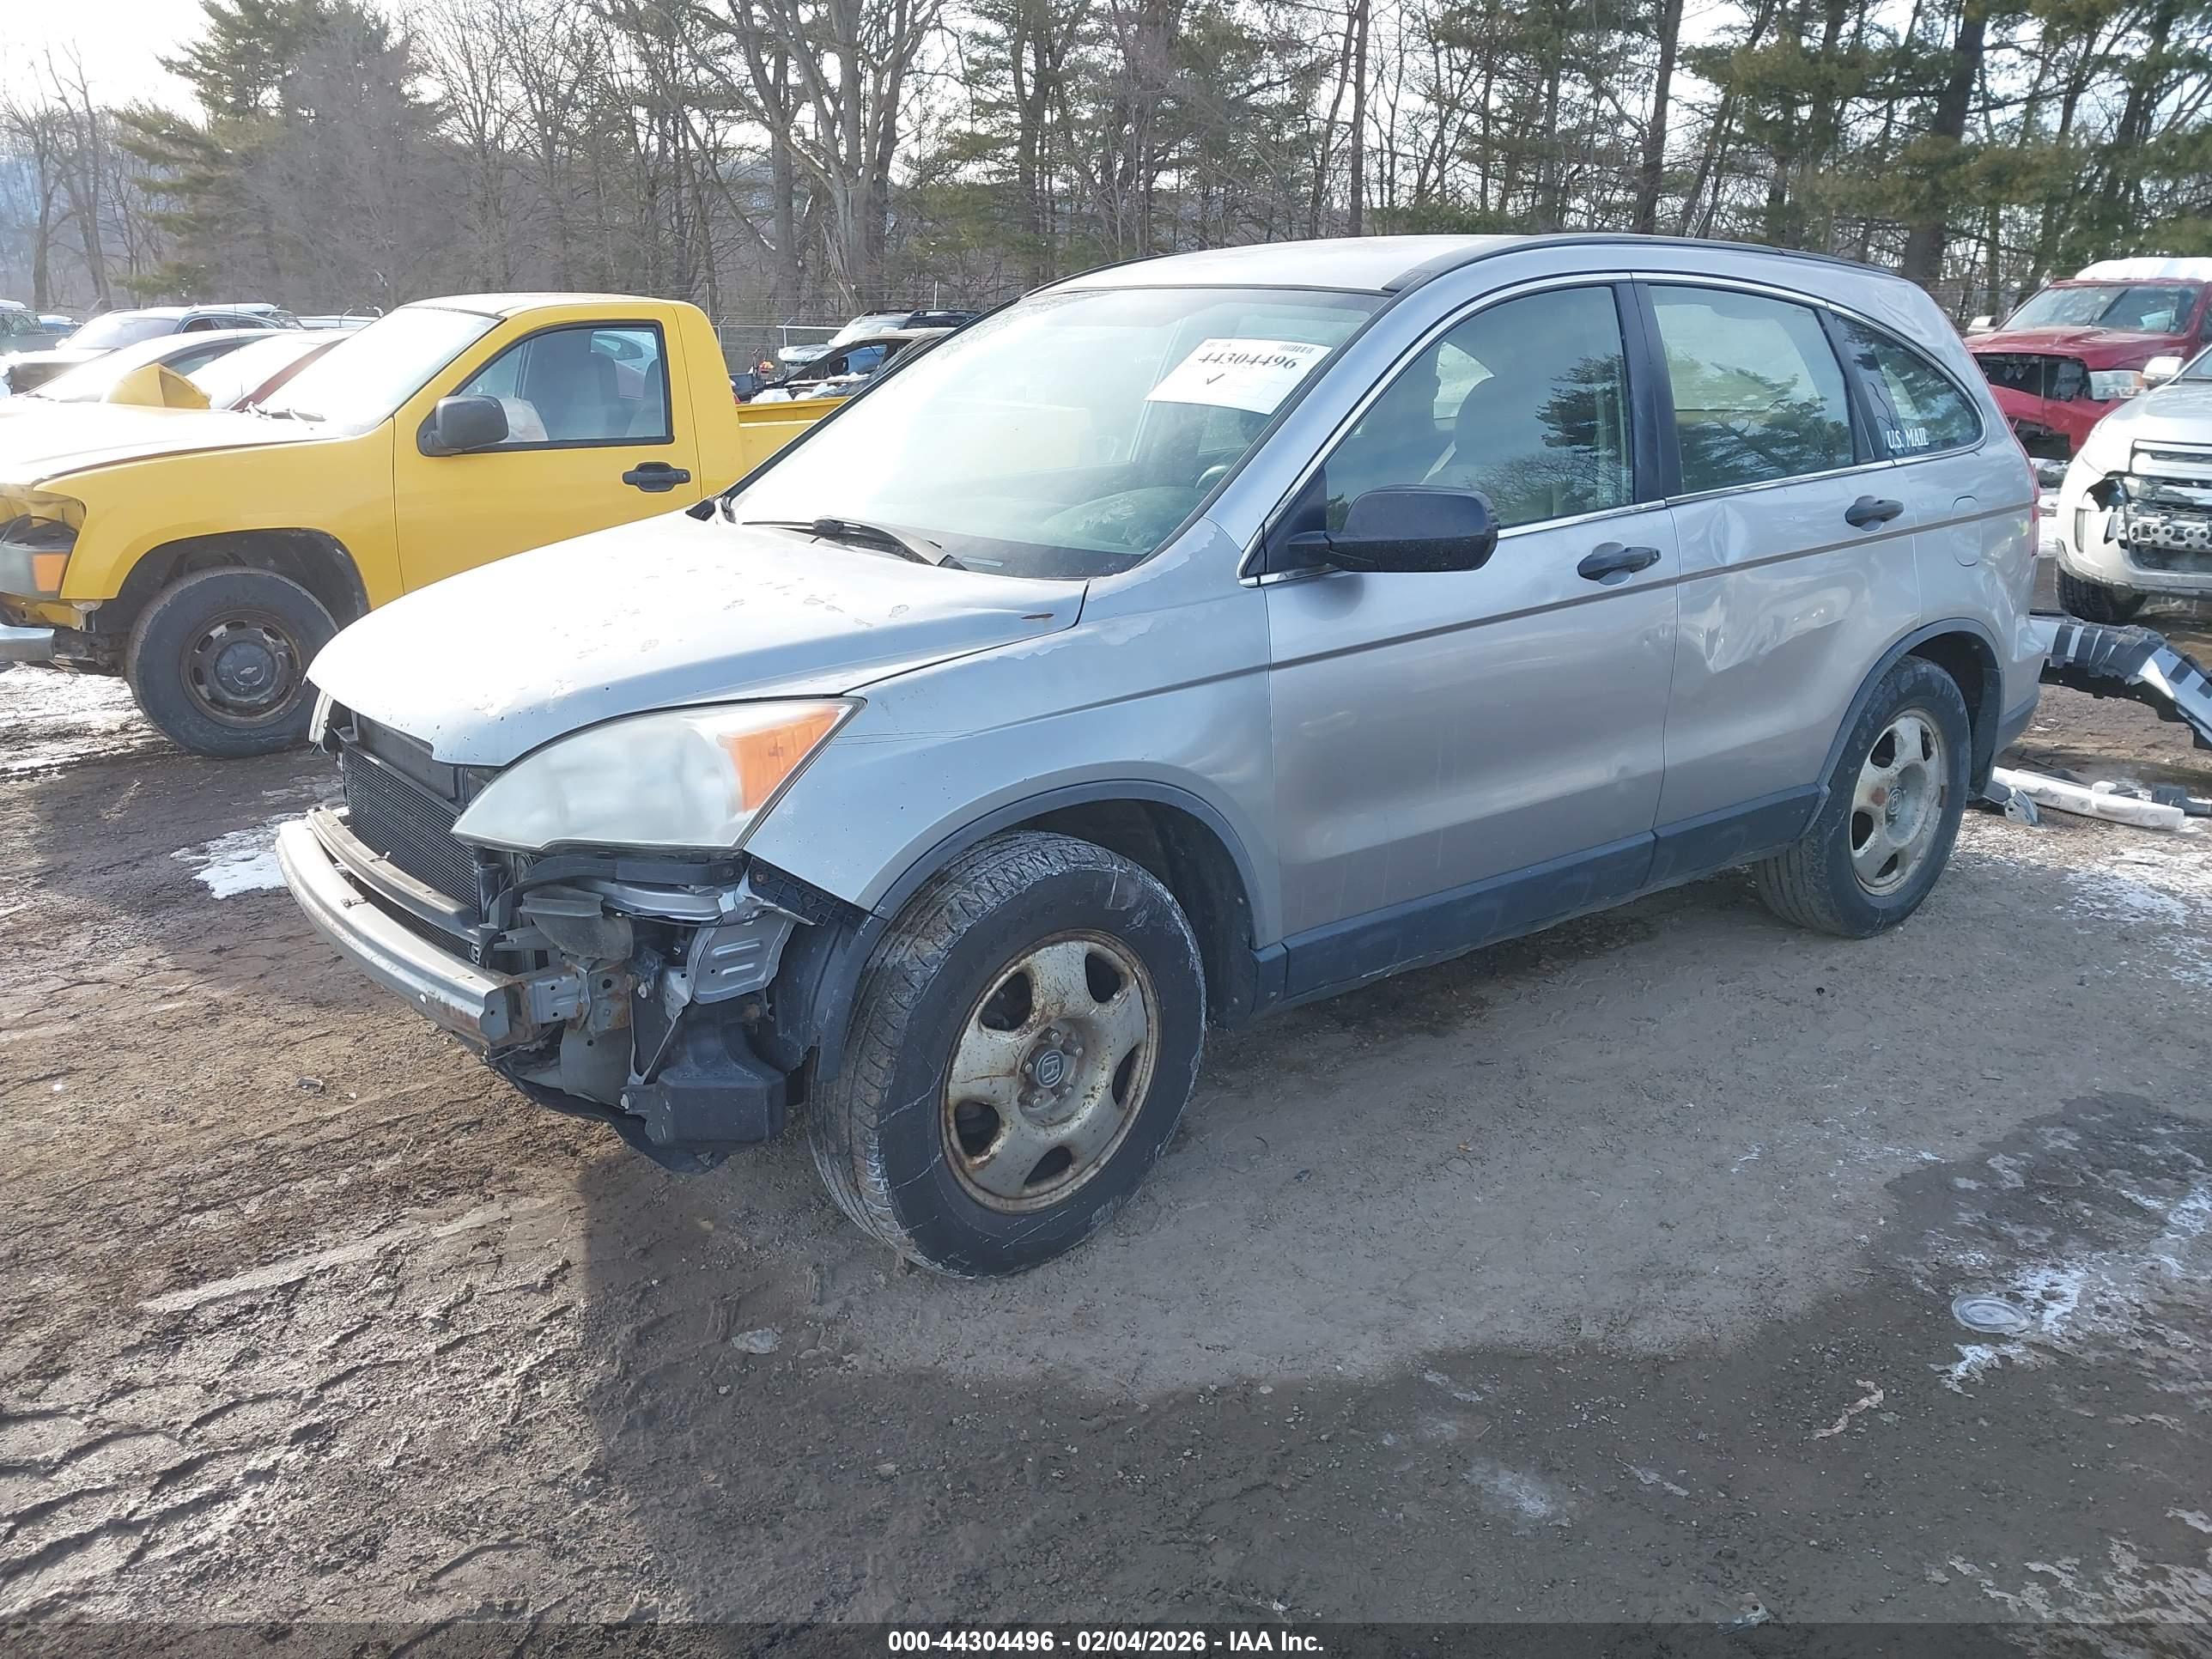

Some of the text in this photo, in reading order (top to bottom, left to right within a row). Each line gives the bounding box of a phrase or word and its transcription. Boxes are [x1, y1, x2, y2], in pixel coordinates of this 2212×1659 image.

[1197, 351, 1301, 370] 44304496
[1887, 428, 1929, 449] U.S. MAIL
